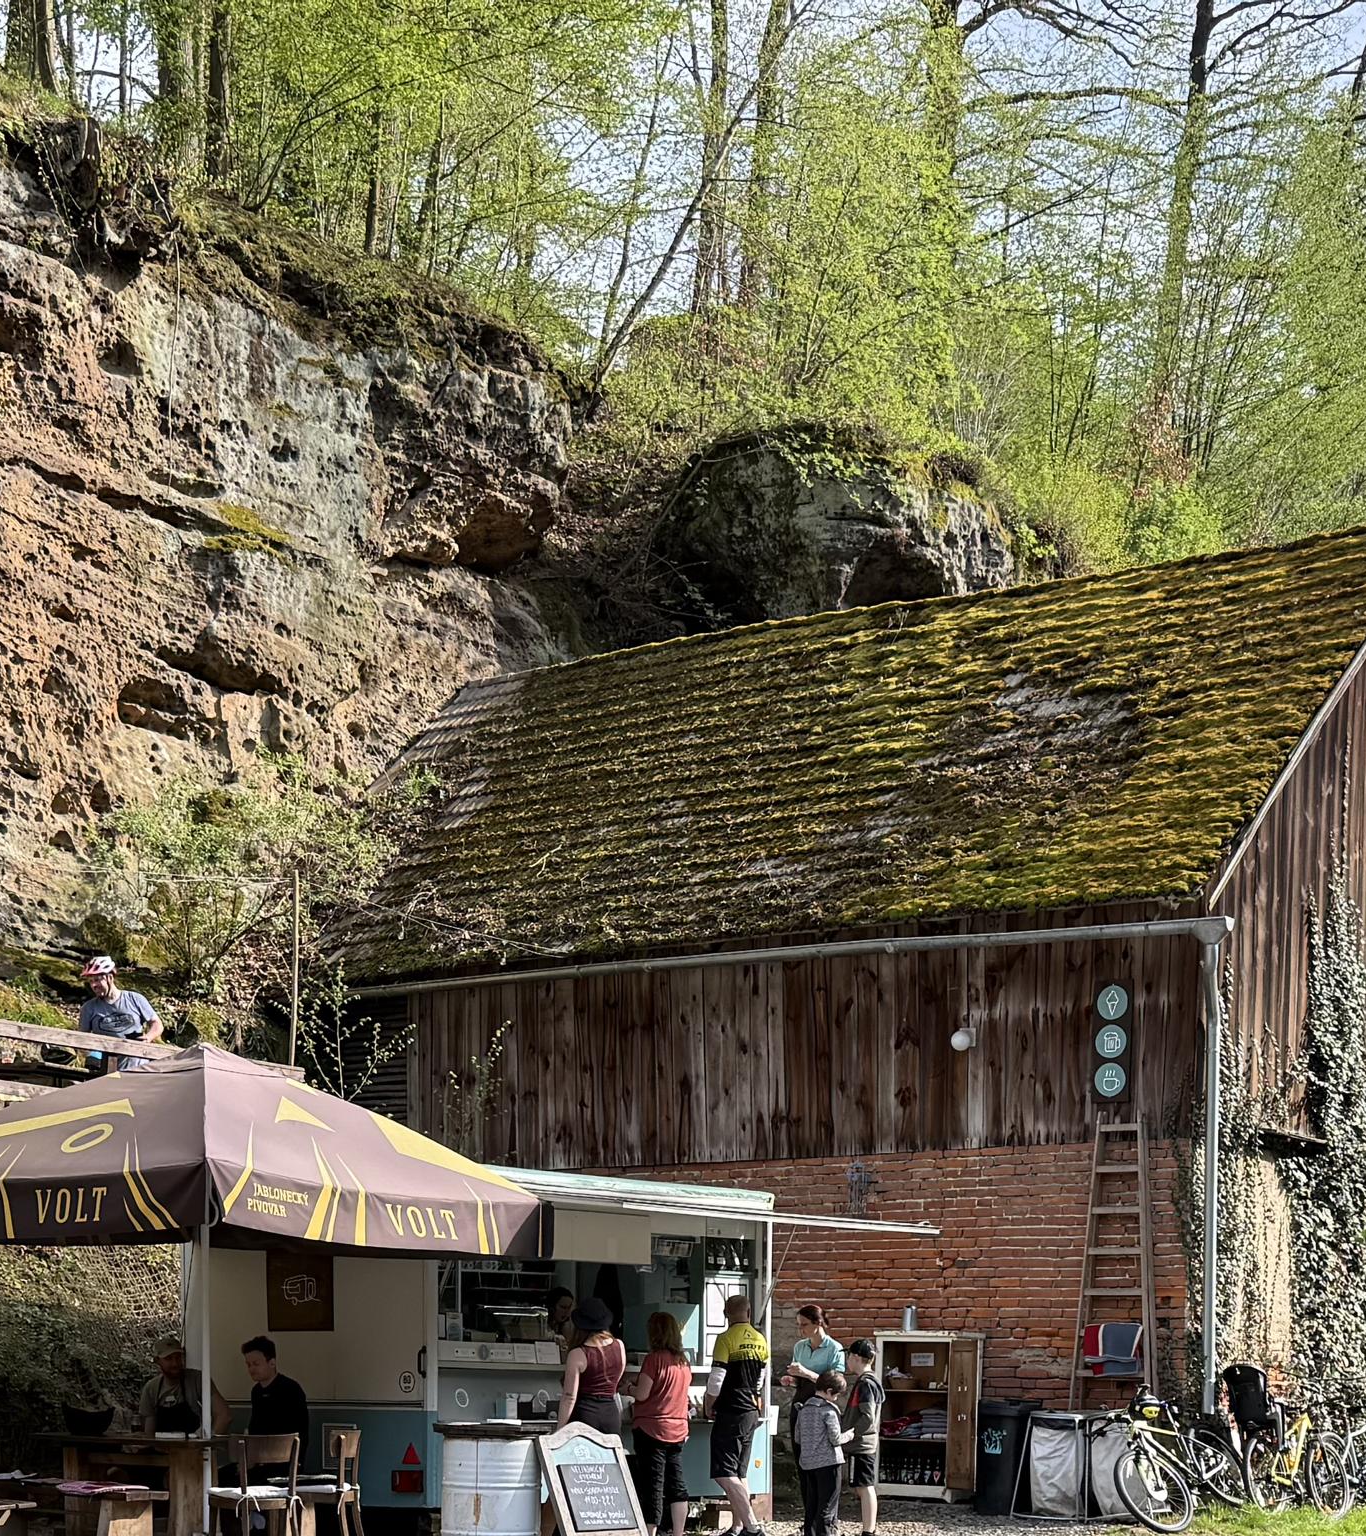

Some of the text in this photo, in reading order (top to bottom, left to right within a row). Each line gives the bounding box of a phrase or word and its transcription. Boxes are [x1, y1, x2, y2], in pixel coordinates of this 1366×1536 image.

[35, 1187, 107, 1224] VOLT
[247, 1198, 287, 1218] PIVOVAR
[253, 1183, 309, 1206] JABLONECKÝ
[385, 1203, 459, 1240] VOLT
